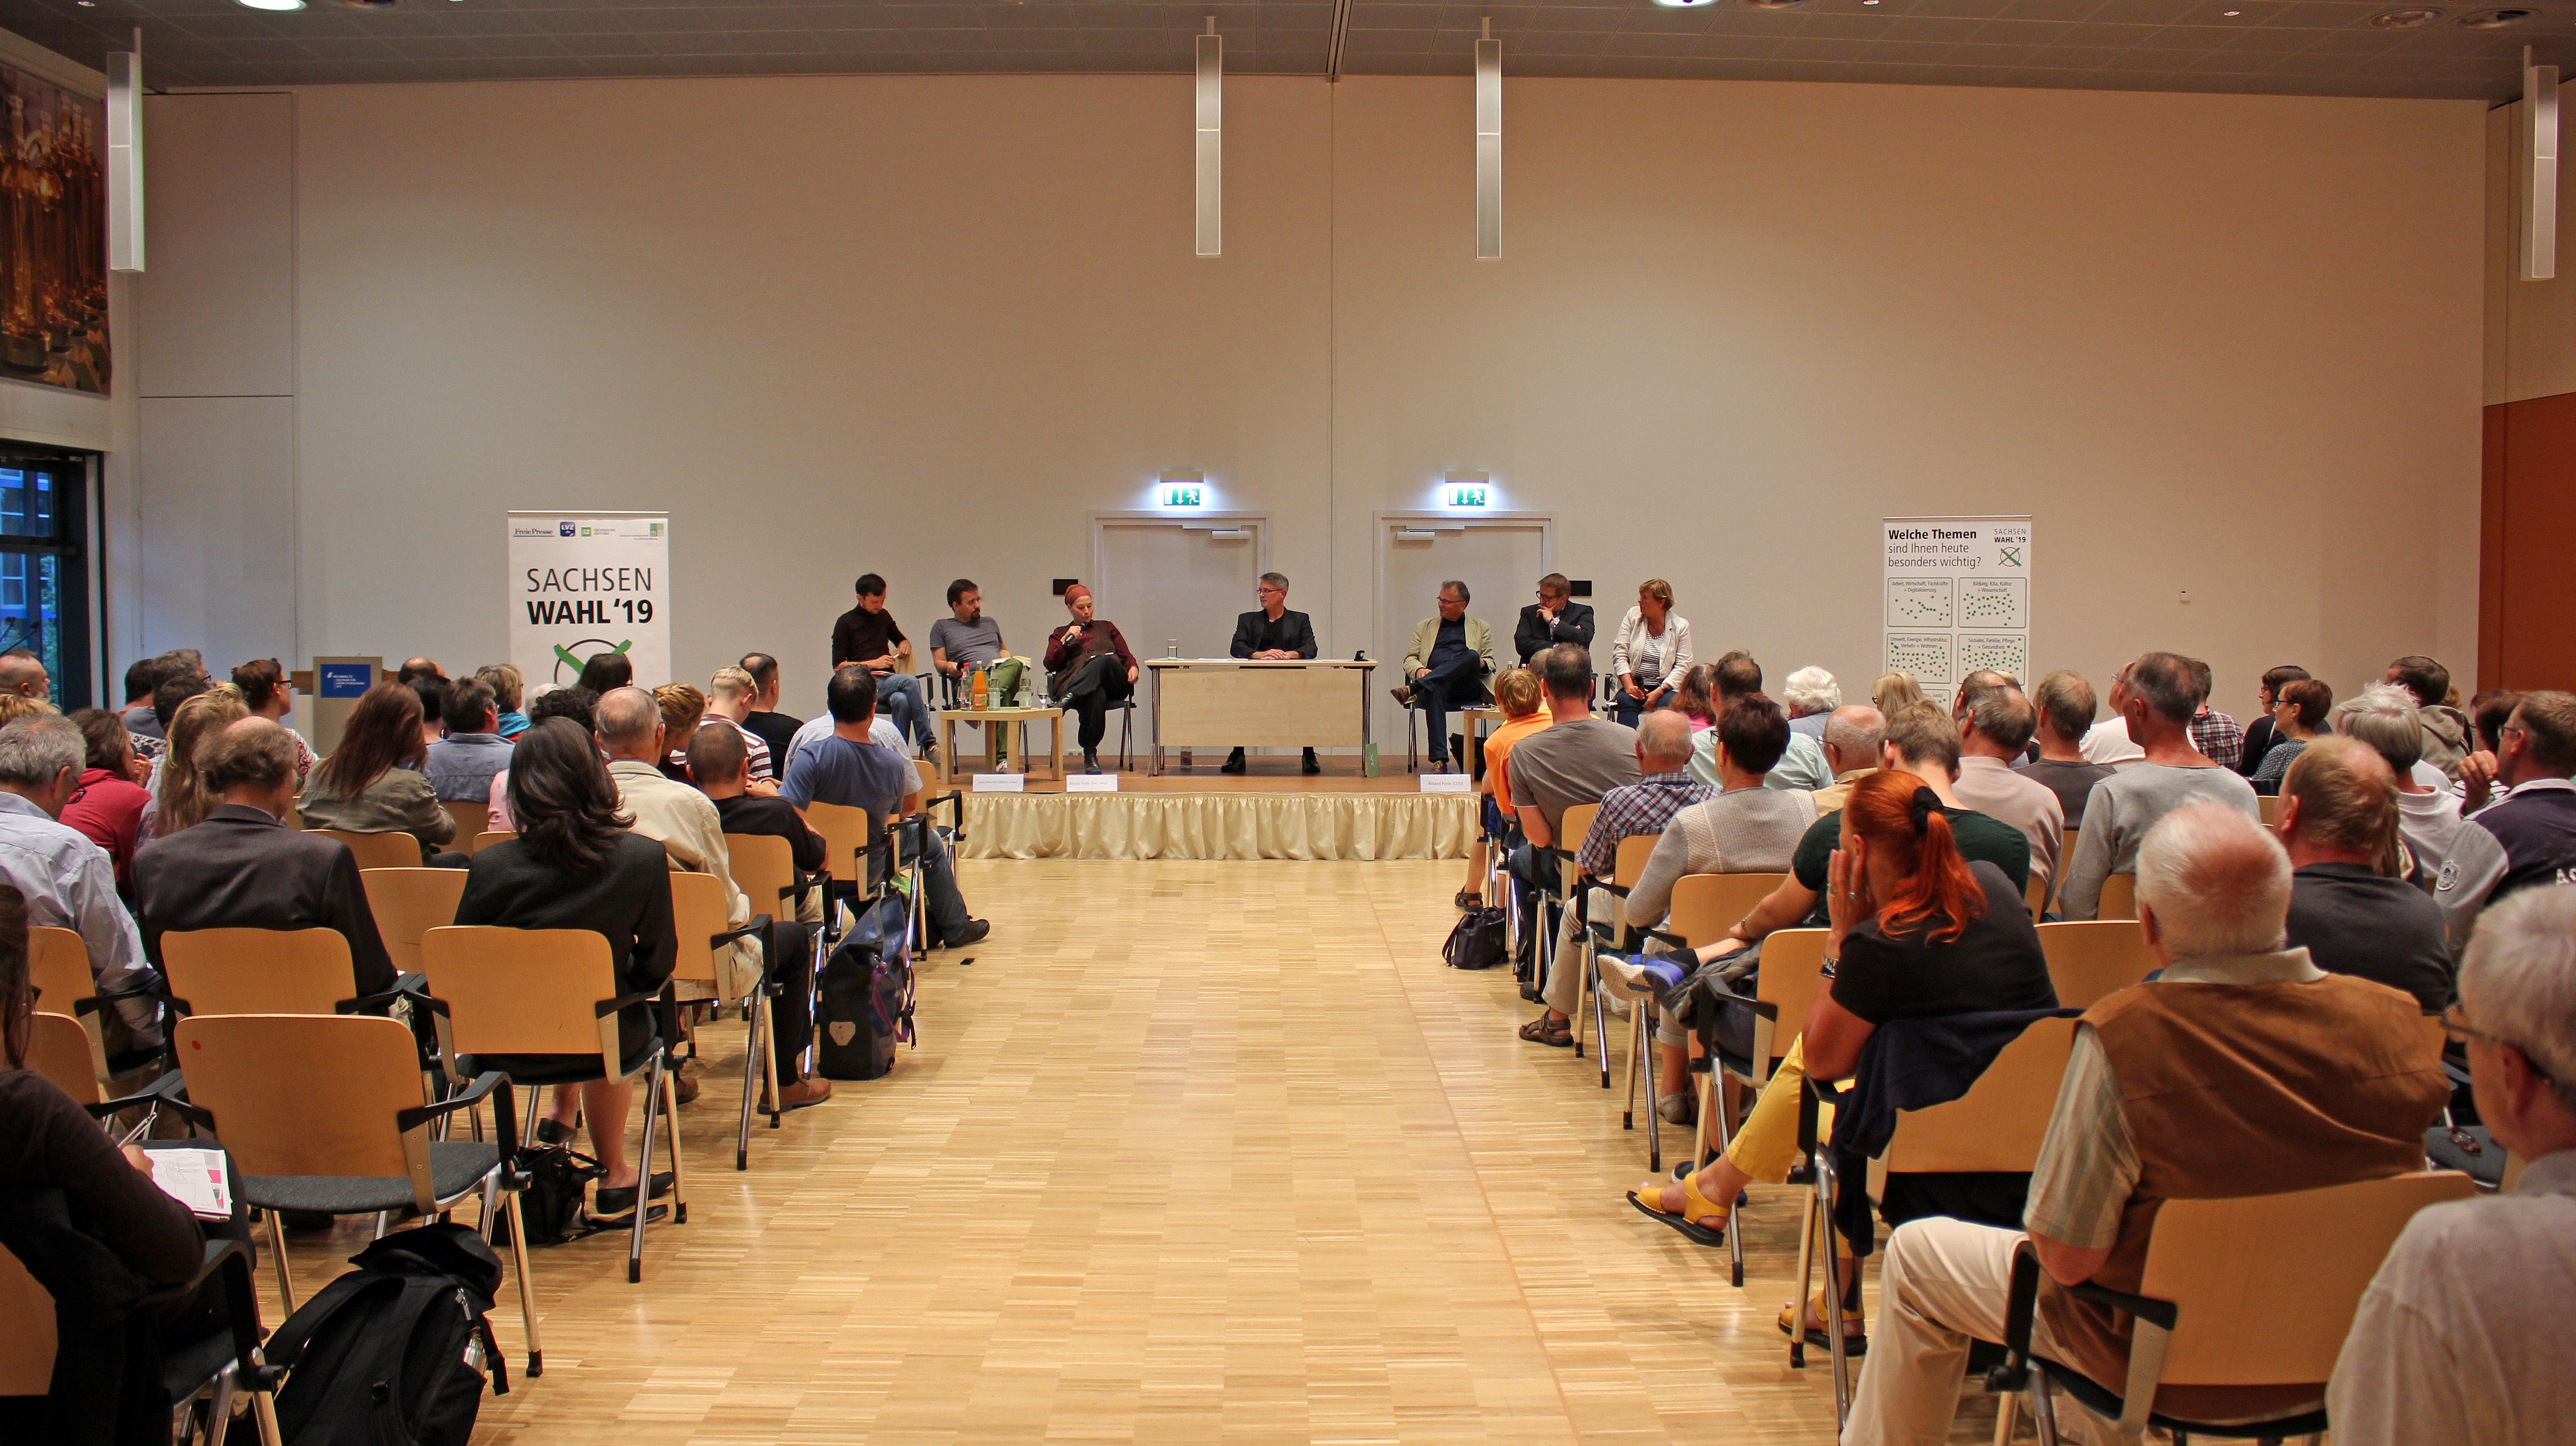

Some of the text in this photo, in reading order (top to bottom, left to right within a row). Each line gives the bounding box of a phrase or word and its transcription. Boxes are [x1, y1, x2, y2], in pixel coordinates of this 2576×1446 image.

[1888, 529, 1977, 540] Welche Themen
[1888, 543, 1969, 554] sind Ihnen heute
[1888, 556, 1981, 569] besonders wichtig?
[527, 567, 651, 592] SACHSEN
